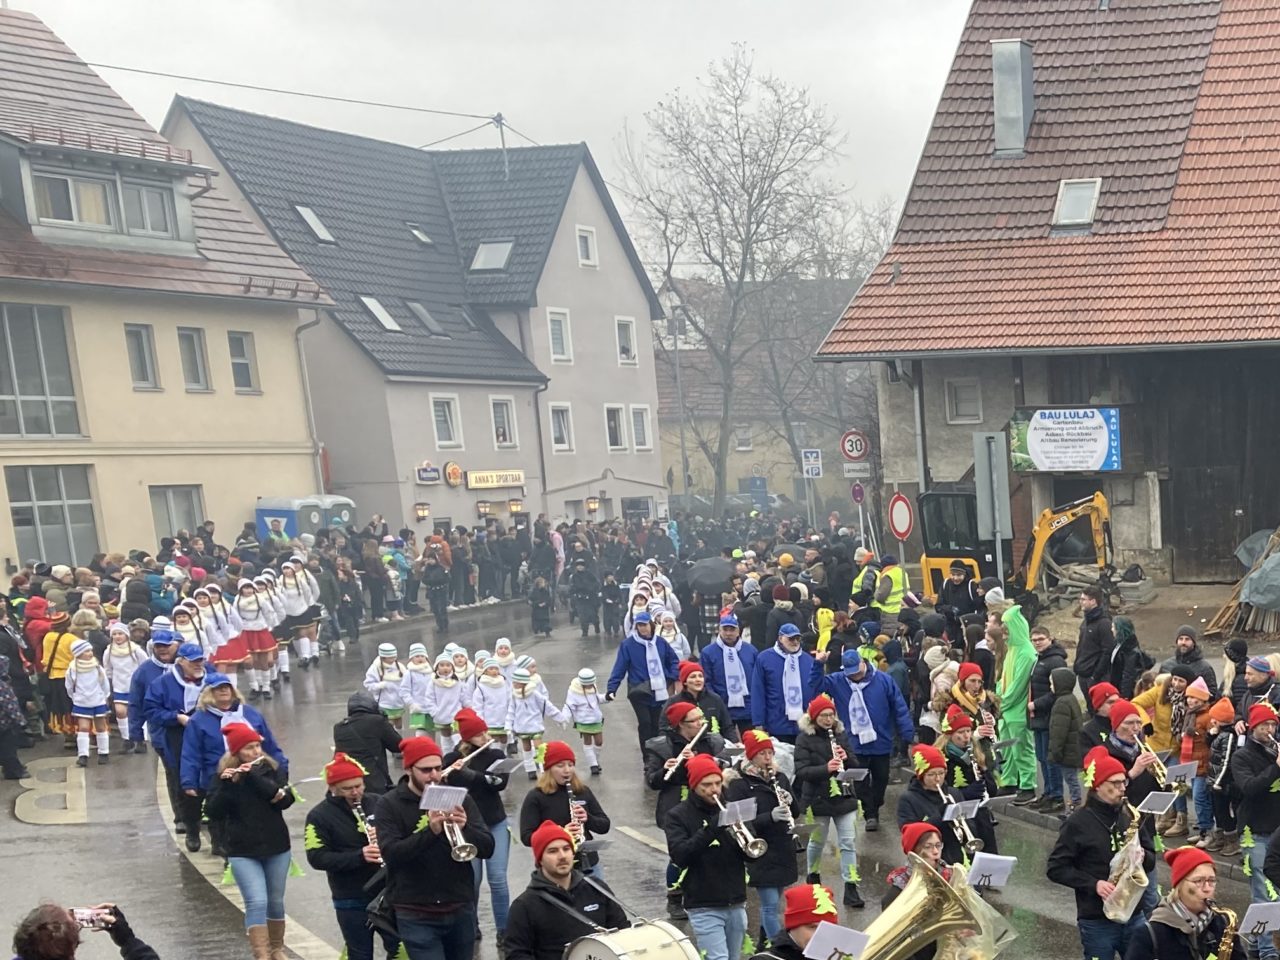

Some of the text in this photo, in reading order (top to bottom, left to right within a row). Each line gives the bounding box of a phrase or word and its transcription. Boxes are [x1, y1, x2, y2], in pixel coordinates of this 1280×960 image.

[1040, 410, 1095, 419] BAU LULAJ
[847, 439, 863, 453] 30
[813, 468, 819, 476] P
[475, 474, 522, 484] ANNA'S SPORTBAR
[1051, 515, 1068, 529] JCB
